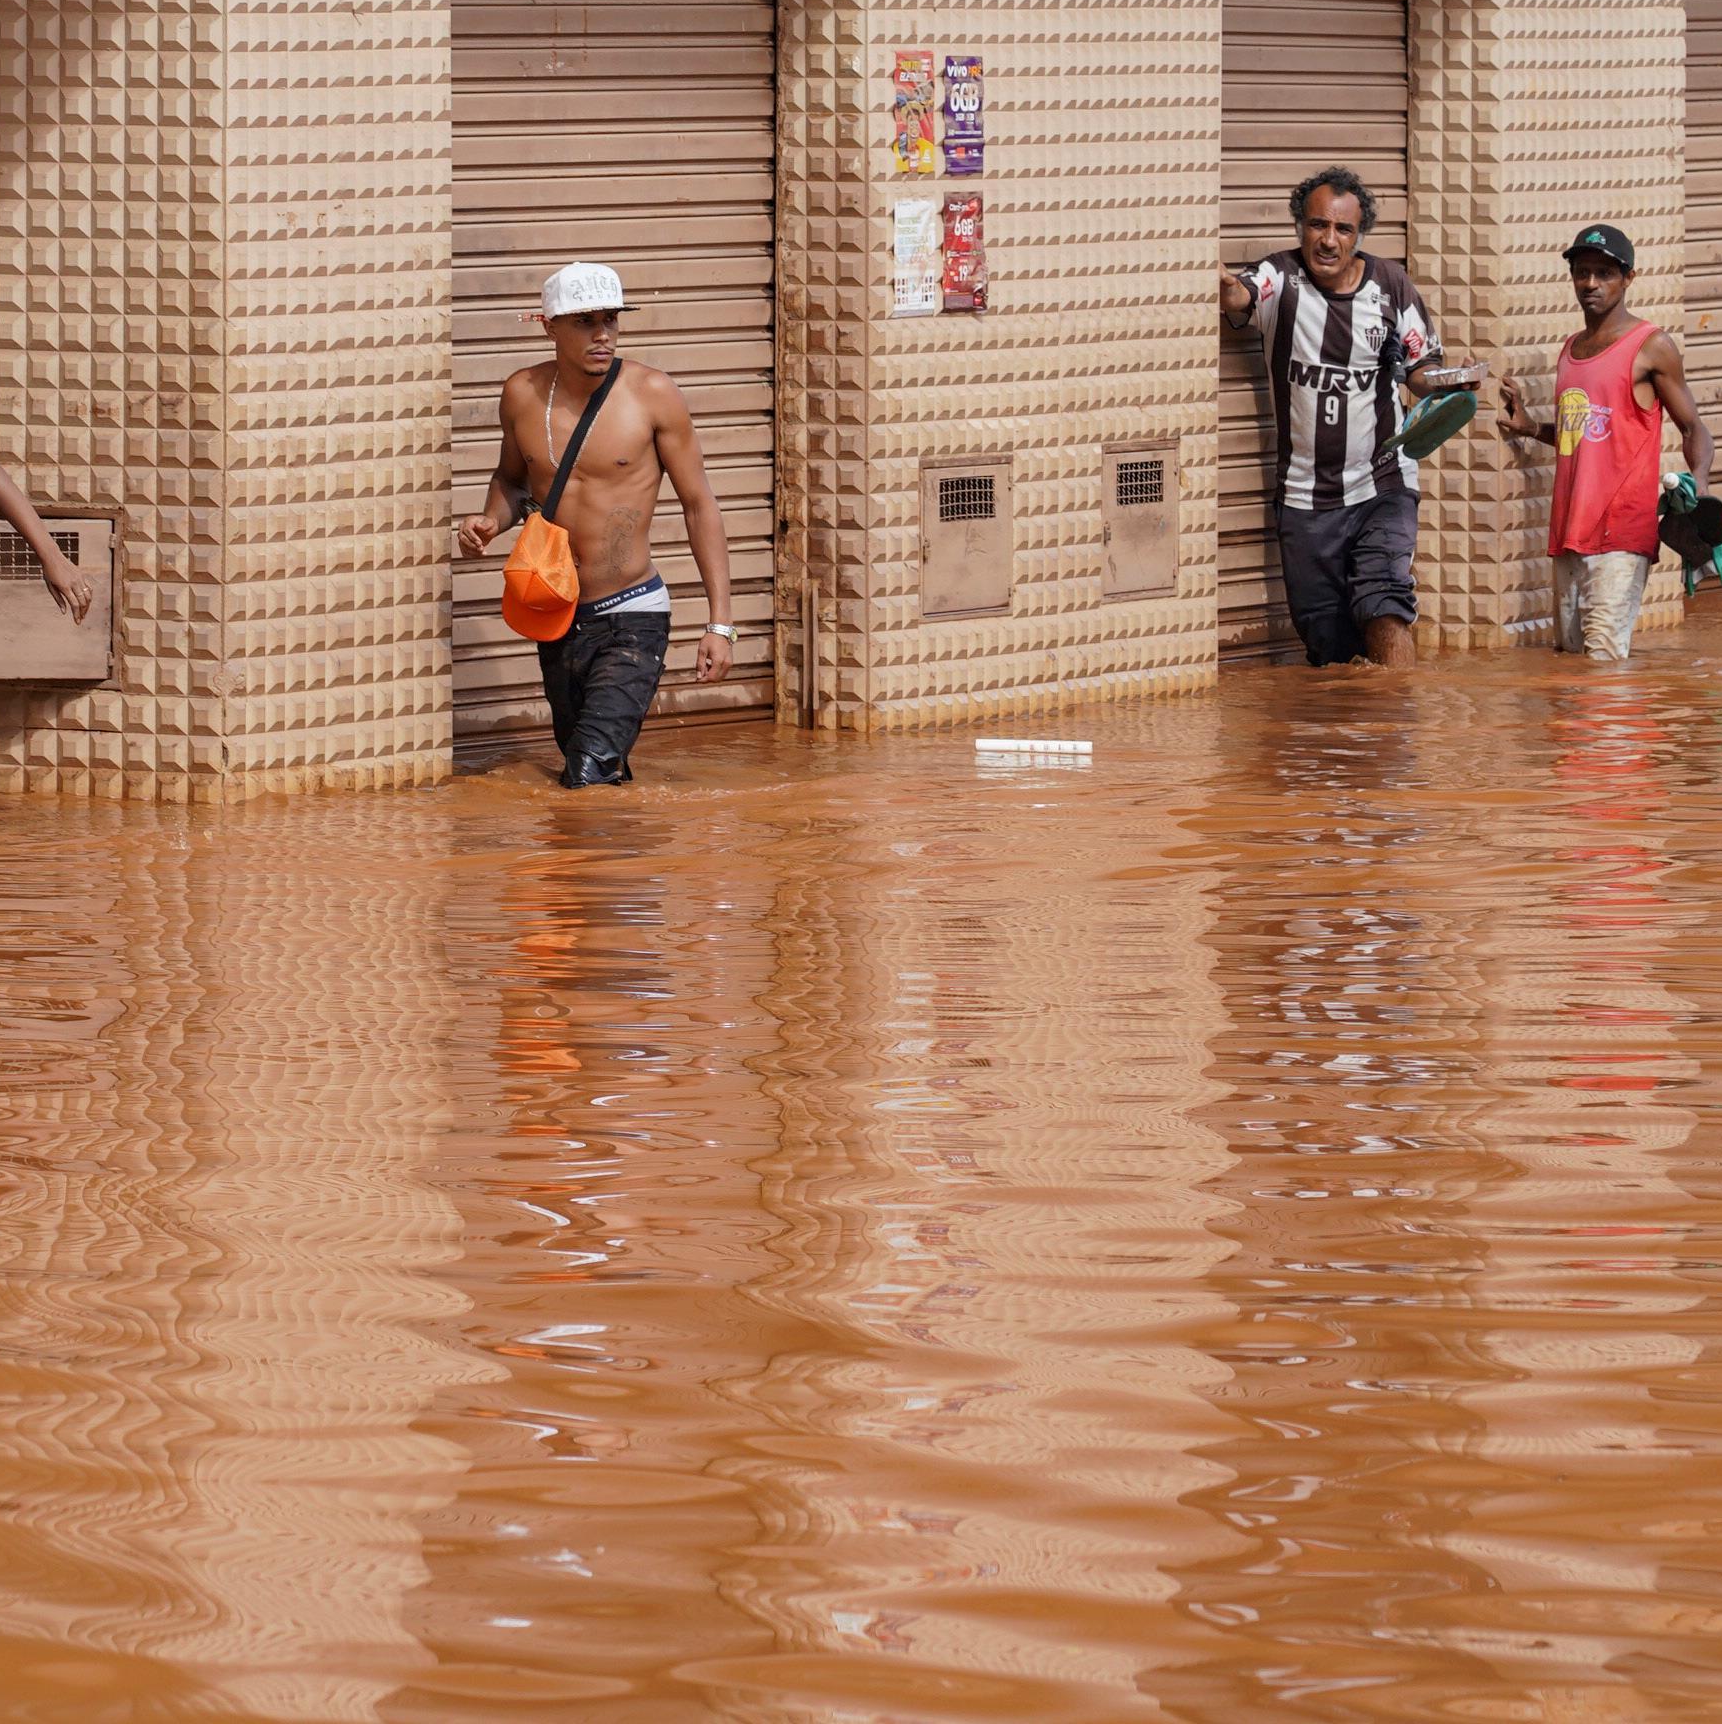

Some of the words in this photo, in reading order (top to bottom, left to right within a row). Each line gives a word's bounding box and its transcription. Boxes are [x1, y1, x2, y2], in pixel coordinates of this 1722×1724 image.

[947, 61, 967, 77] vivo
[950, 82, 979, 112] 6GB
[954, 215, 974, 236] 6GB
[1289, 360, 1380, 392] MRV
[1324, 395, 1340, 426] 9
